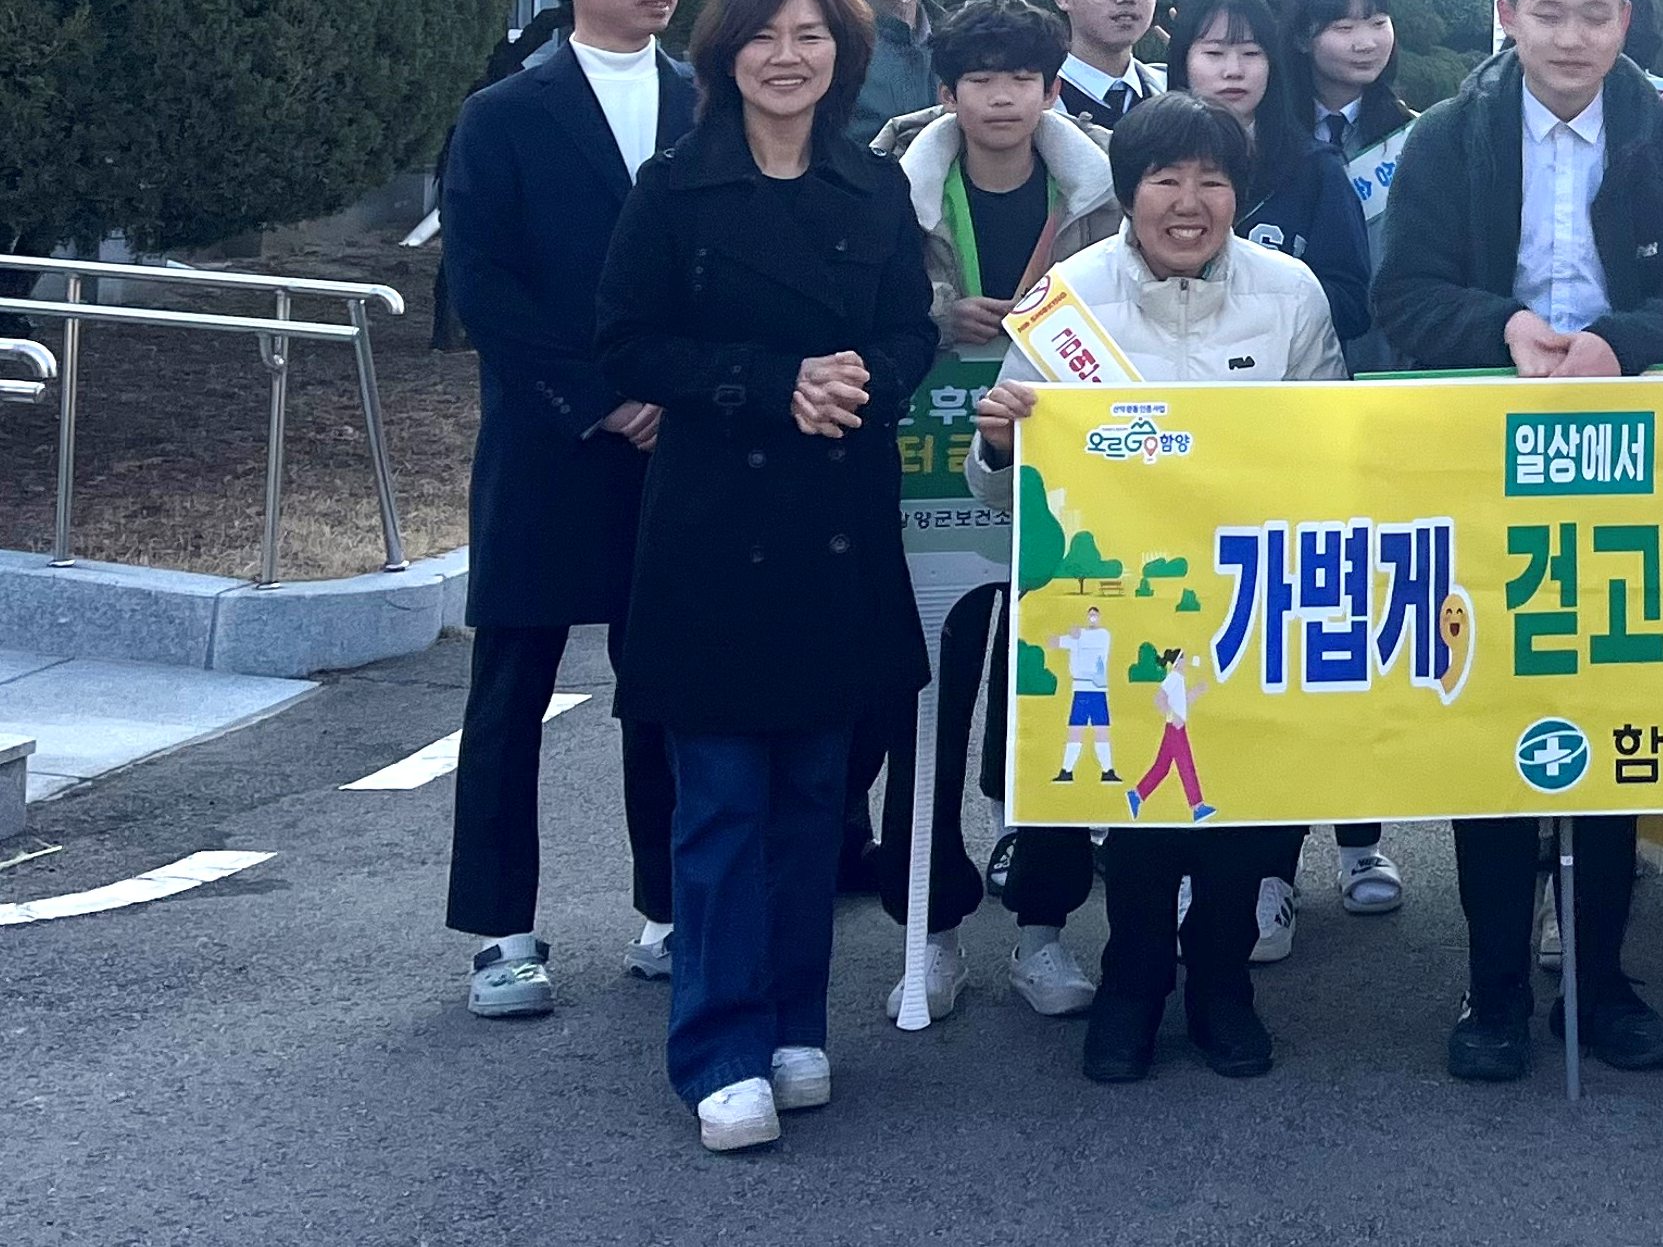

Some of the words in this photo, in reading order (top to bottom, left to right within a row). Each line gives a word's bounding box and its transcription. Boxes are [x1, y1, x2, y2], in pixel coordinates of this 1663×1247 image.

[1051, 327, 1102, 383] 금연
[1159, 433, 1191, 453] 함양
[1514, 422, 1646, 486] 일상에서
[1213, 520, 1455, 687] 가볍게
